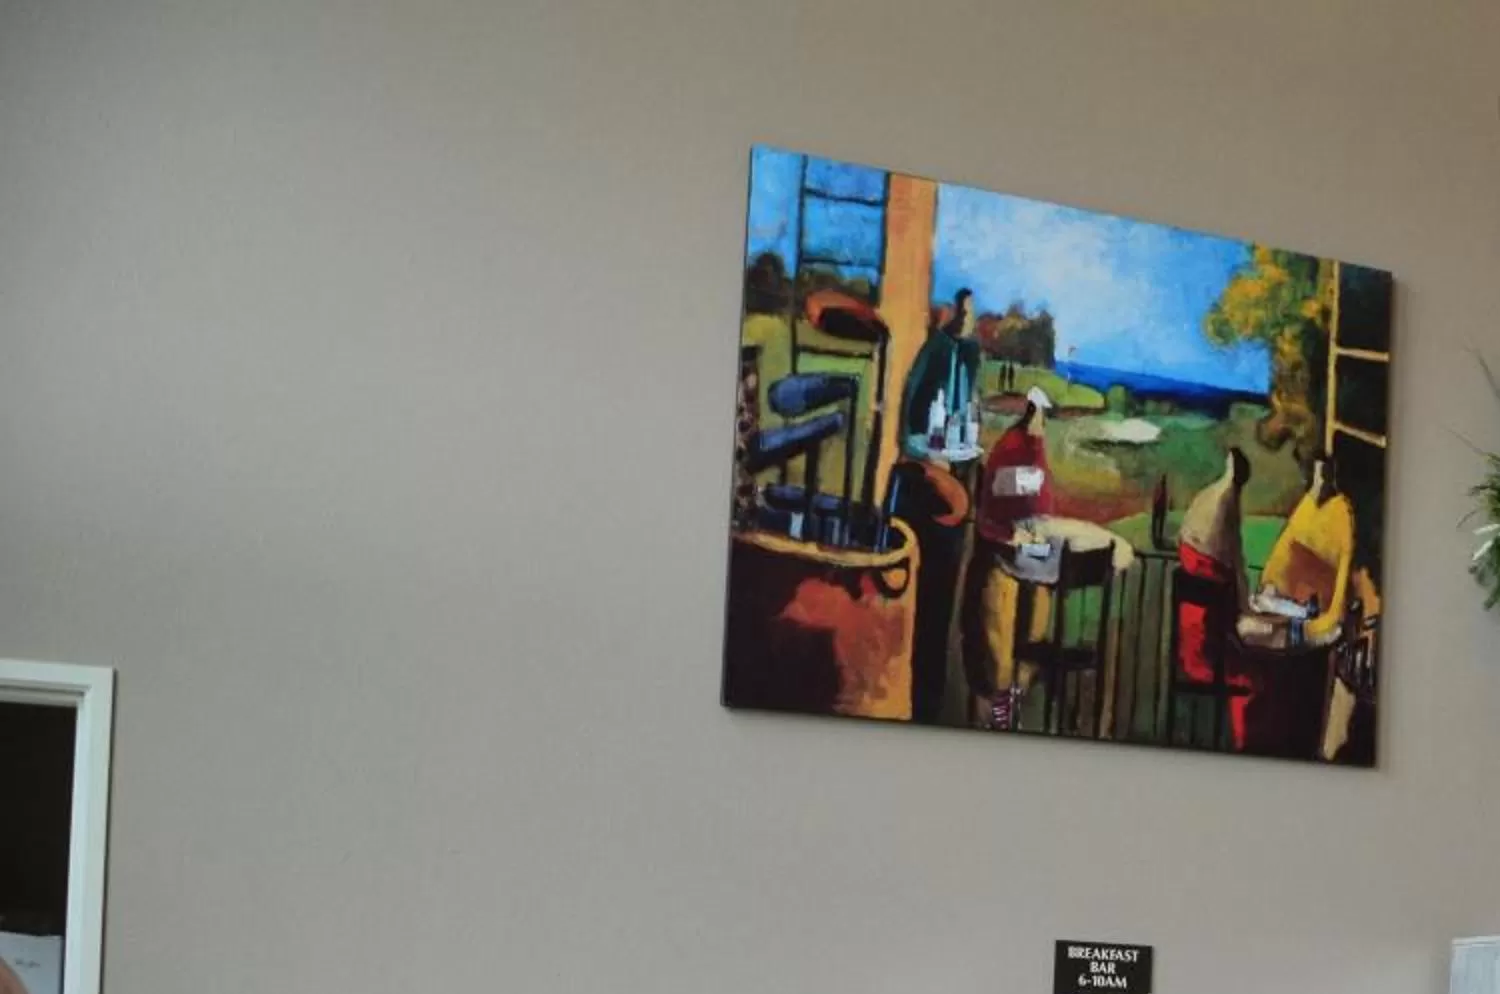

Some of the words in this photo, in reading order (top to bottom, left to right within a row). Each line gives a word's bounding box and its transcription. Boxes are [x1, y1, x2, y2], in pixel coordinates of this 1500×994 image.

[1067, 945, 1139, 962] BREAKFAST
[1090, 961, 1116, 974] BAR
[1078, 973, 1127, 989] 6-10AM
